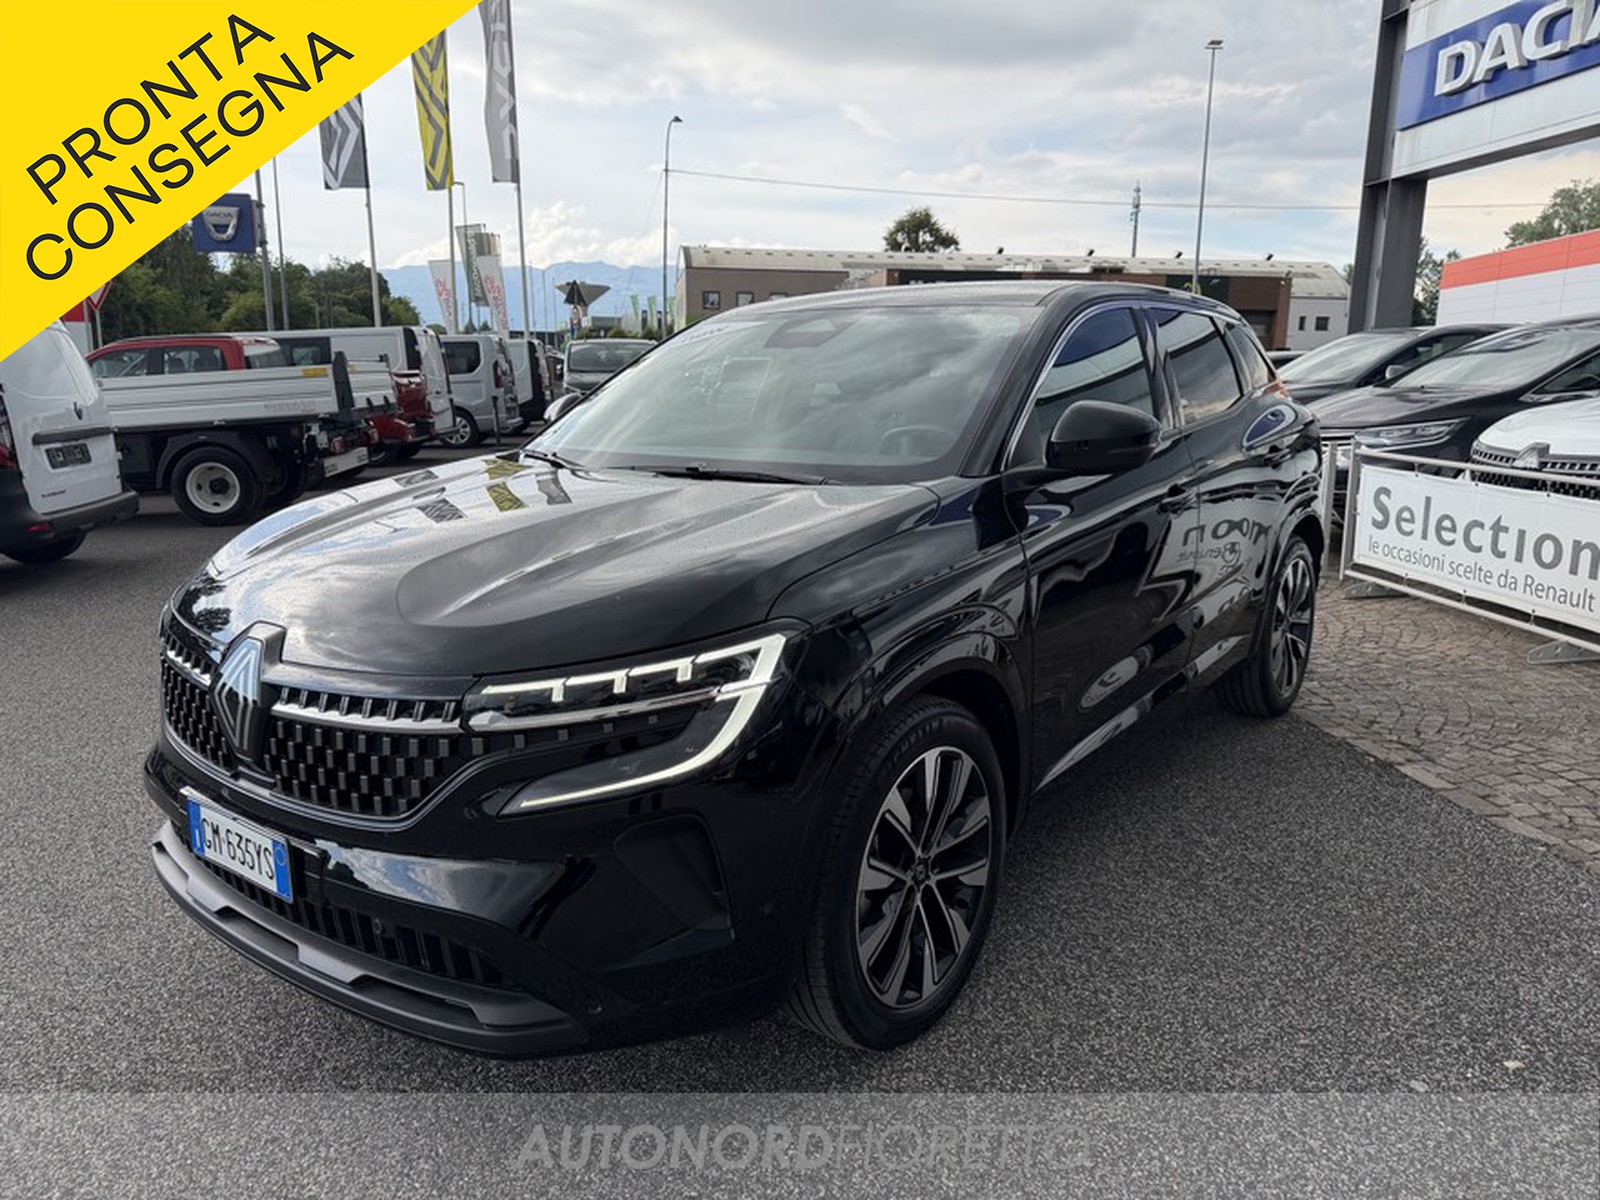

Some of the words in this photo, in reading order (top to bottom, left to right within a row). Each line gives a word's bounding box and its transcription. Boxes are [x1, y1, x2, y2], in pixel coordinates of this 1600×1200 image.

[1370, 486, 1600, 581] Selection
[1368, 534, 1379, 554] le
[1382, 543, 1446, 572] occasioni
[1448, 561, 1494, 585] scelte
[1497, 569, 1518, 591] da
[1523, 574, 1596, 612] Renault
[225, 828, 275, 880] 635YS
